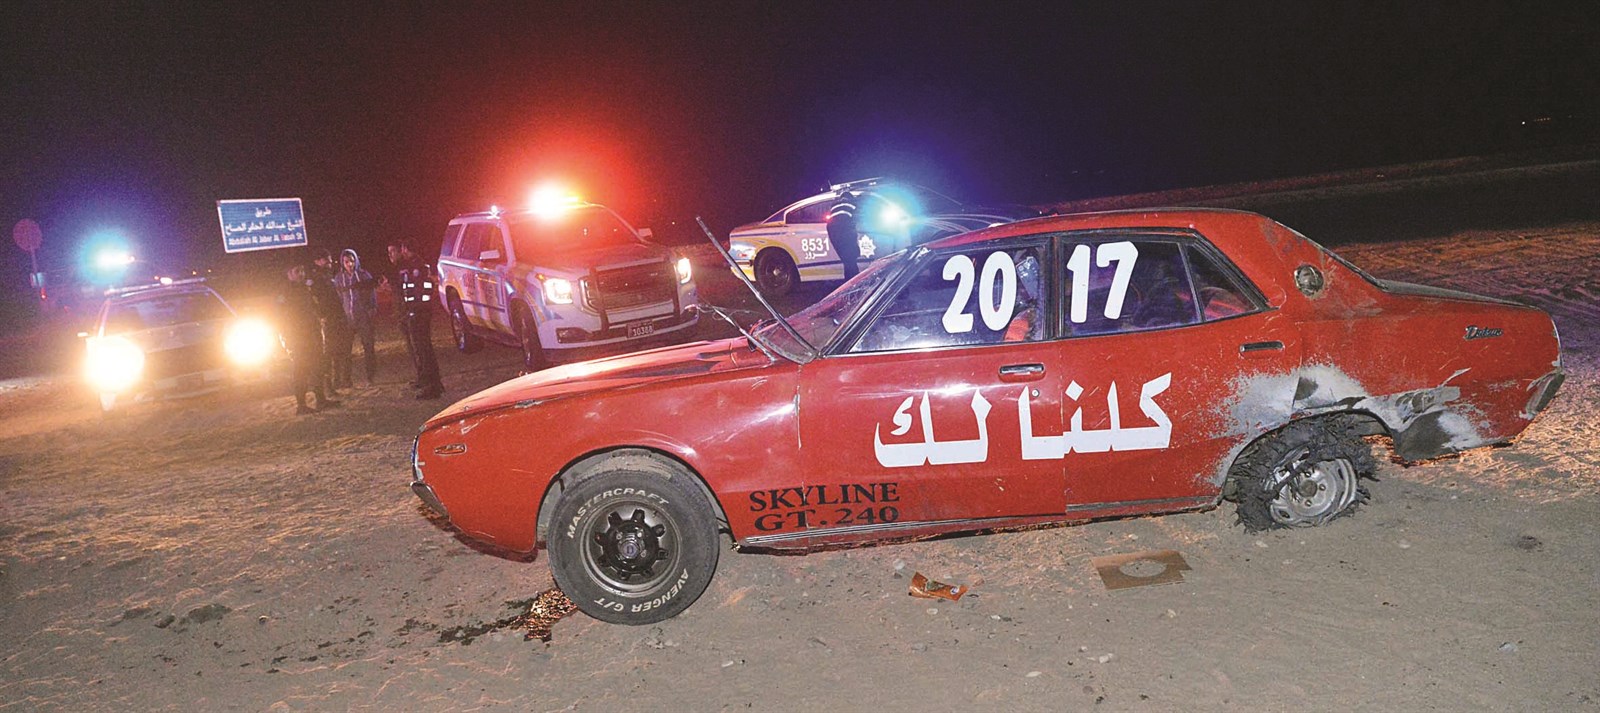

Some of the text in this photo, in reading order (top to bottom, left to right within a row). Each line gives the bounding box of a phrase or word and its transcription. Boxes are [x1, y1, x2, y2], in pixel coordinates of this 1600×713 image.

[801, 237, 830, 252] 8531
[942, 241, 1139, 333] 20 17
[874, 372, 1173, 468] كلنا لك
[566, 487, 669, 539] MASTERCRAFT
[749, 482, 900, 512] SKYLINE
[594, 568, 689, 613] AVENGER G/T
